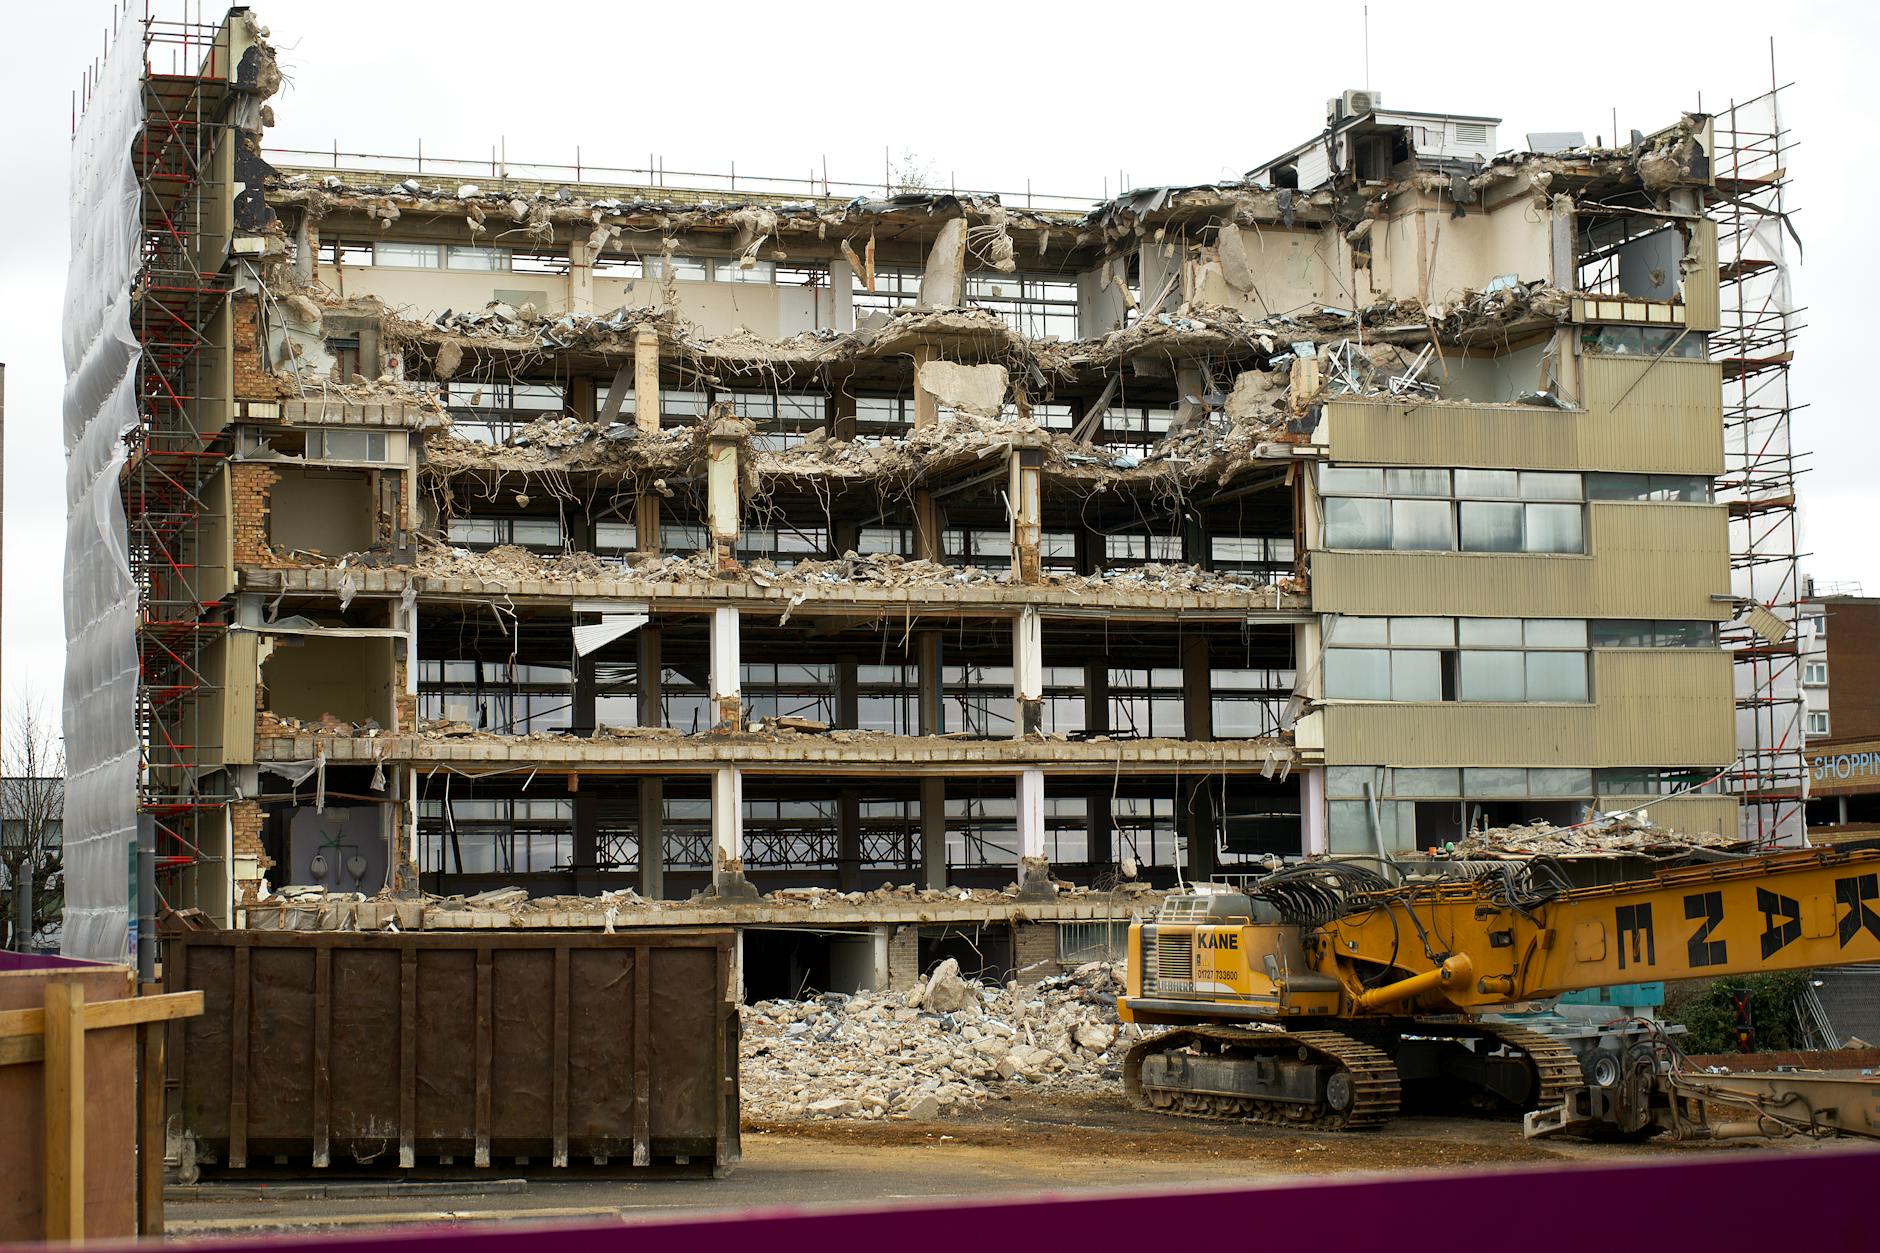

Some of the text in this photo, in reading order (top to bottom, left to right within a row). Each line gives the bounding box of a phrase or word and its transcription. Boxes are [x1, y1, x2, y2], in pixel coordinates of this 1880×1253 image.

[1197, 933, 1238, 949] KANE
[1198, 970, 1238, 980] 01727 733600
[1159, 981, 1194, 992] LIEBHERR
